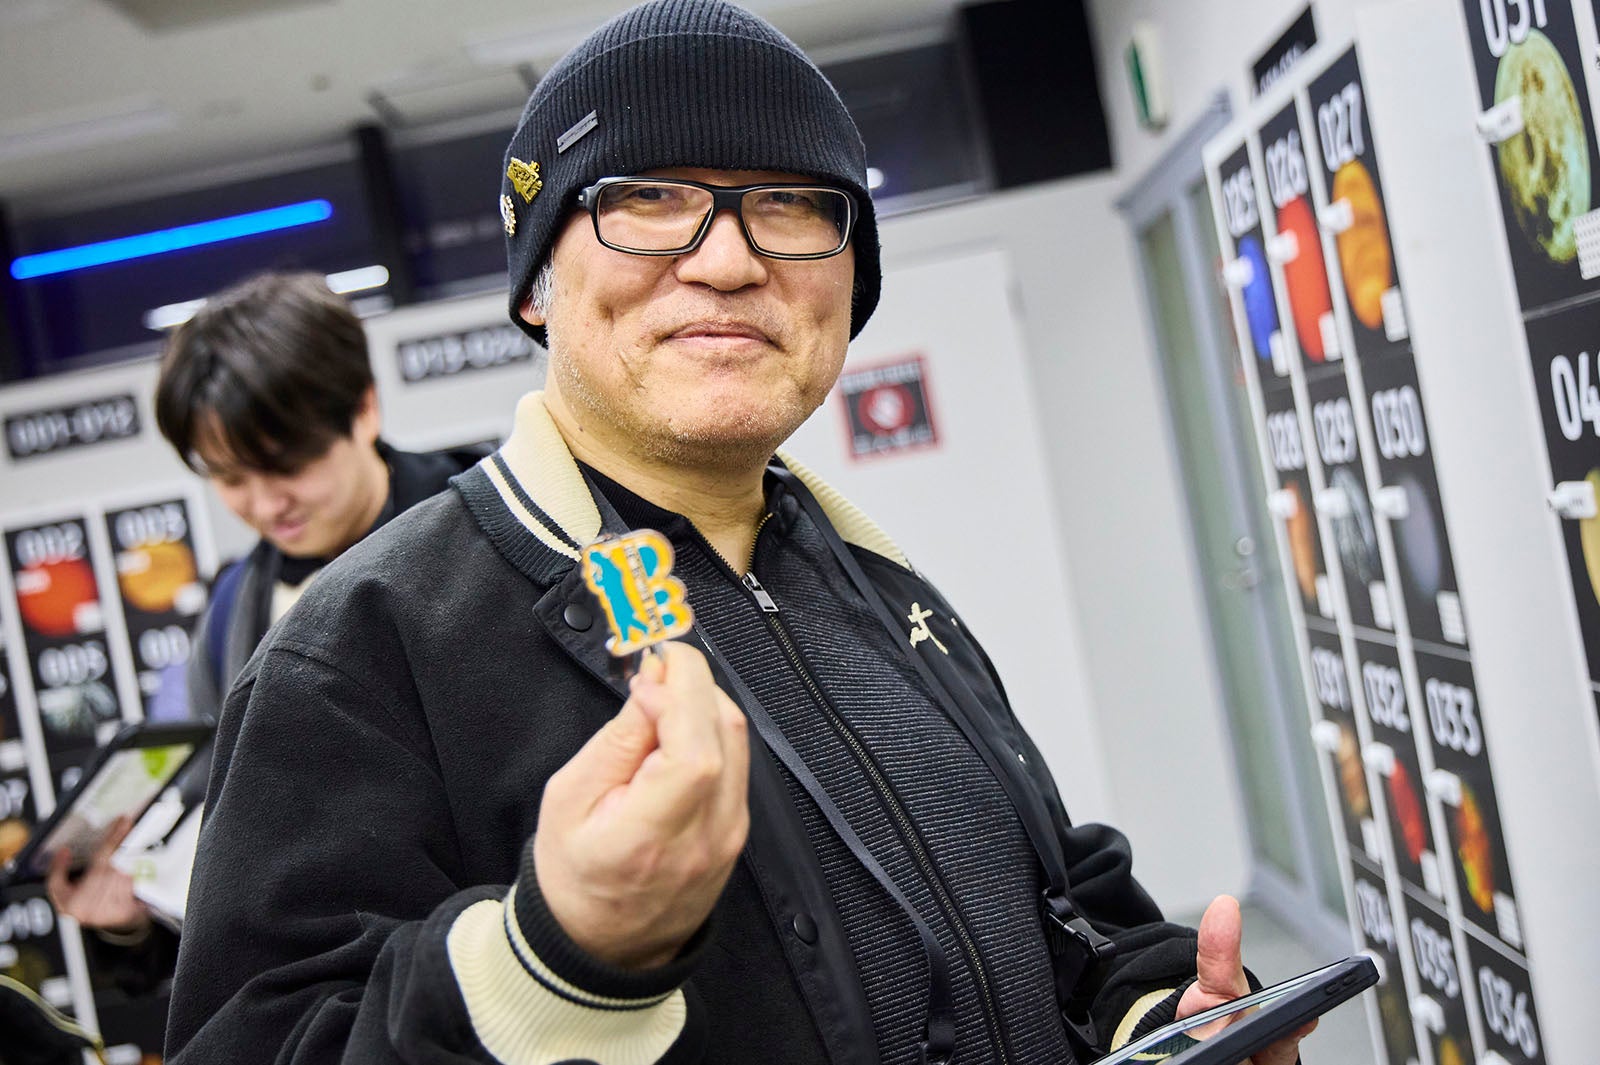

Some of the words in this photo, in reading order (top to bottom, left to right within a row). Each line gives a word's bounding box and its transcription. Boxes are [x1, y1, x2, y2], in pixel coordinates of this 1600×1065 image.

[1318, 82, 1364, 172] 027
[1265, 128, 1308, 209] 026
[1313, 397, 1357, 466] 029
[1371, 384, 1425, 460] 030
[1551, 352, 1600, 441] 04
[15, 521, 85, 568] 002
[138, 625, 191, 669] 00
[1362, 660, 1411, 733] 032
[1425, 676, 1482, 757] 033
[1410, 917, 1459, 998] 035
[1478, 965, 1538, 1059] 036
